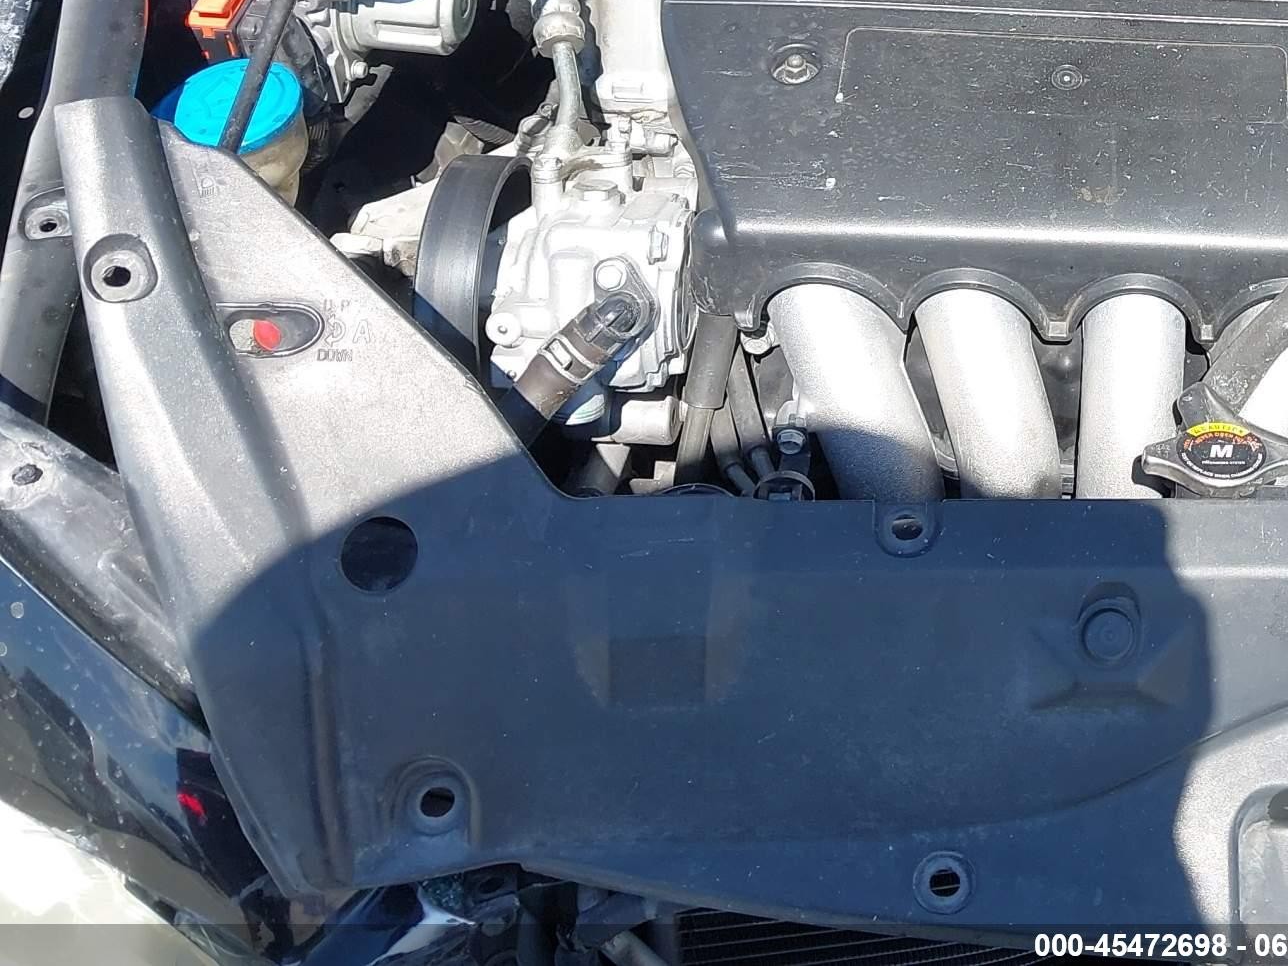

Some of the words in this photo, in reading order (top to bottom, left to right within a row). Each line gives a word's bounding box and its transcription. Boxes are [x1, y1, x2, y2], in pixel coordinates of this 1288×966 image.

[352, 318, 371, 344] A
[317, 348, 353, 362] DOWN
[1210, 445, 1234, 458] M
